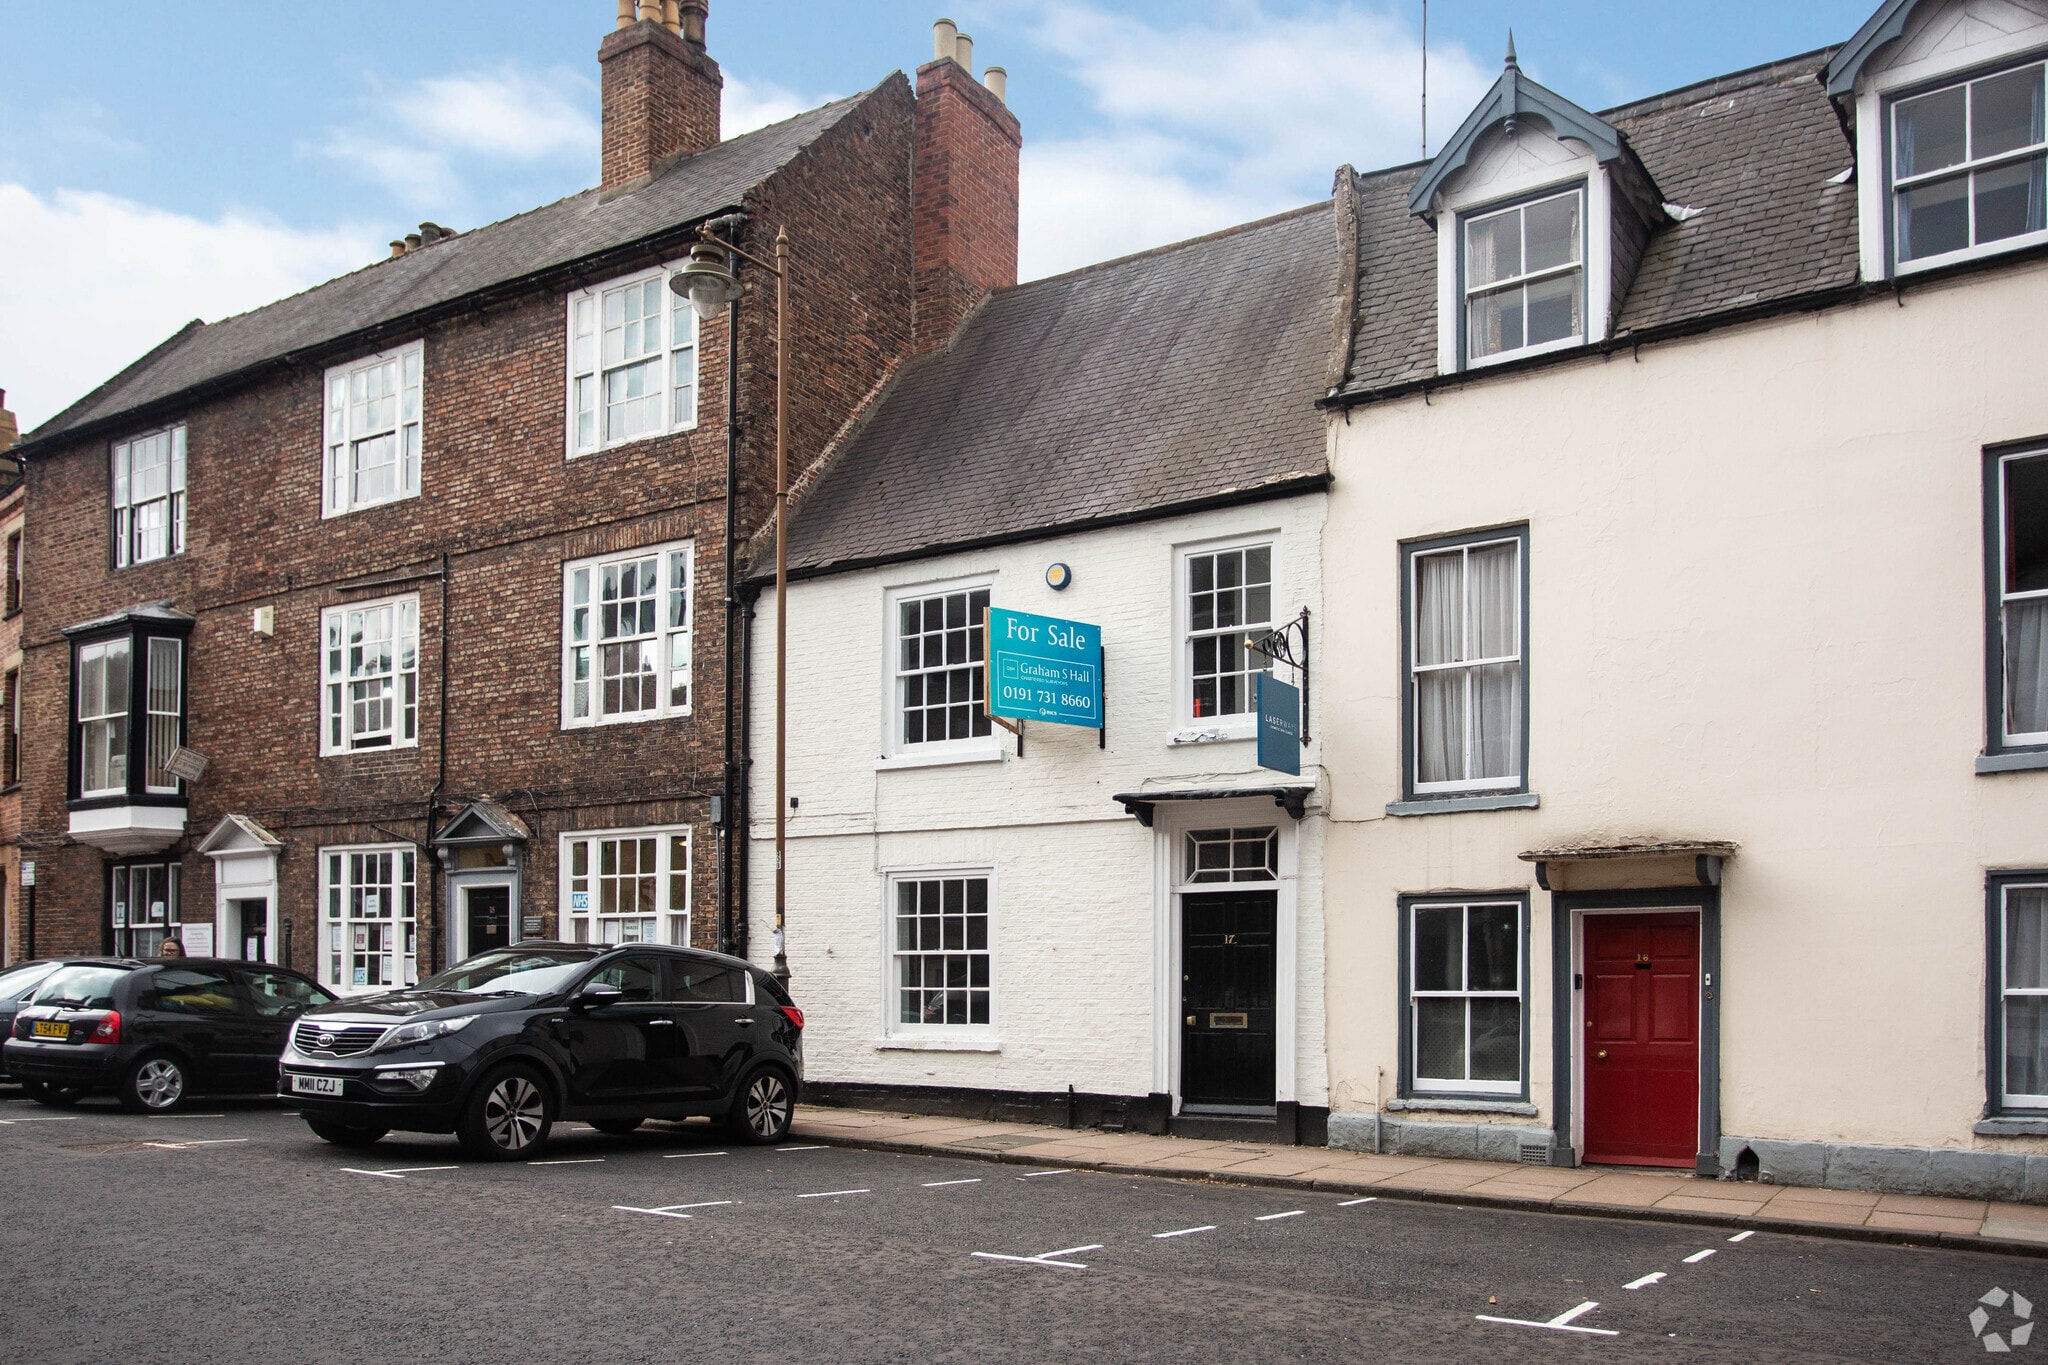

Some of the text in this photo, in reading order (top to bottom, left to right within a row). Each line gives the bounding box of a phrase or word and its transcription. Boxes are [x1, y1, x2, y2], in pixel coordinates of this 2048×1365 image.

[1007, 617, 1086, 650] For Sale
[1020, 662, 1060, 679] Graham
[1062, 669, 1068, 680] S
[1070, 669, 1090, 683] Hall
[1003, 685, 1091, 708] 0191 731 8660
[573, 894, 588, 908] NHS
[1224, 934, 1236, 945] 17
[316, 1079, 335, 1092] CZJ
